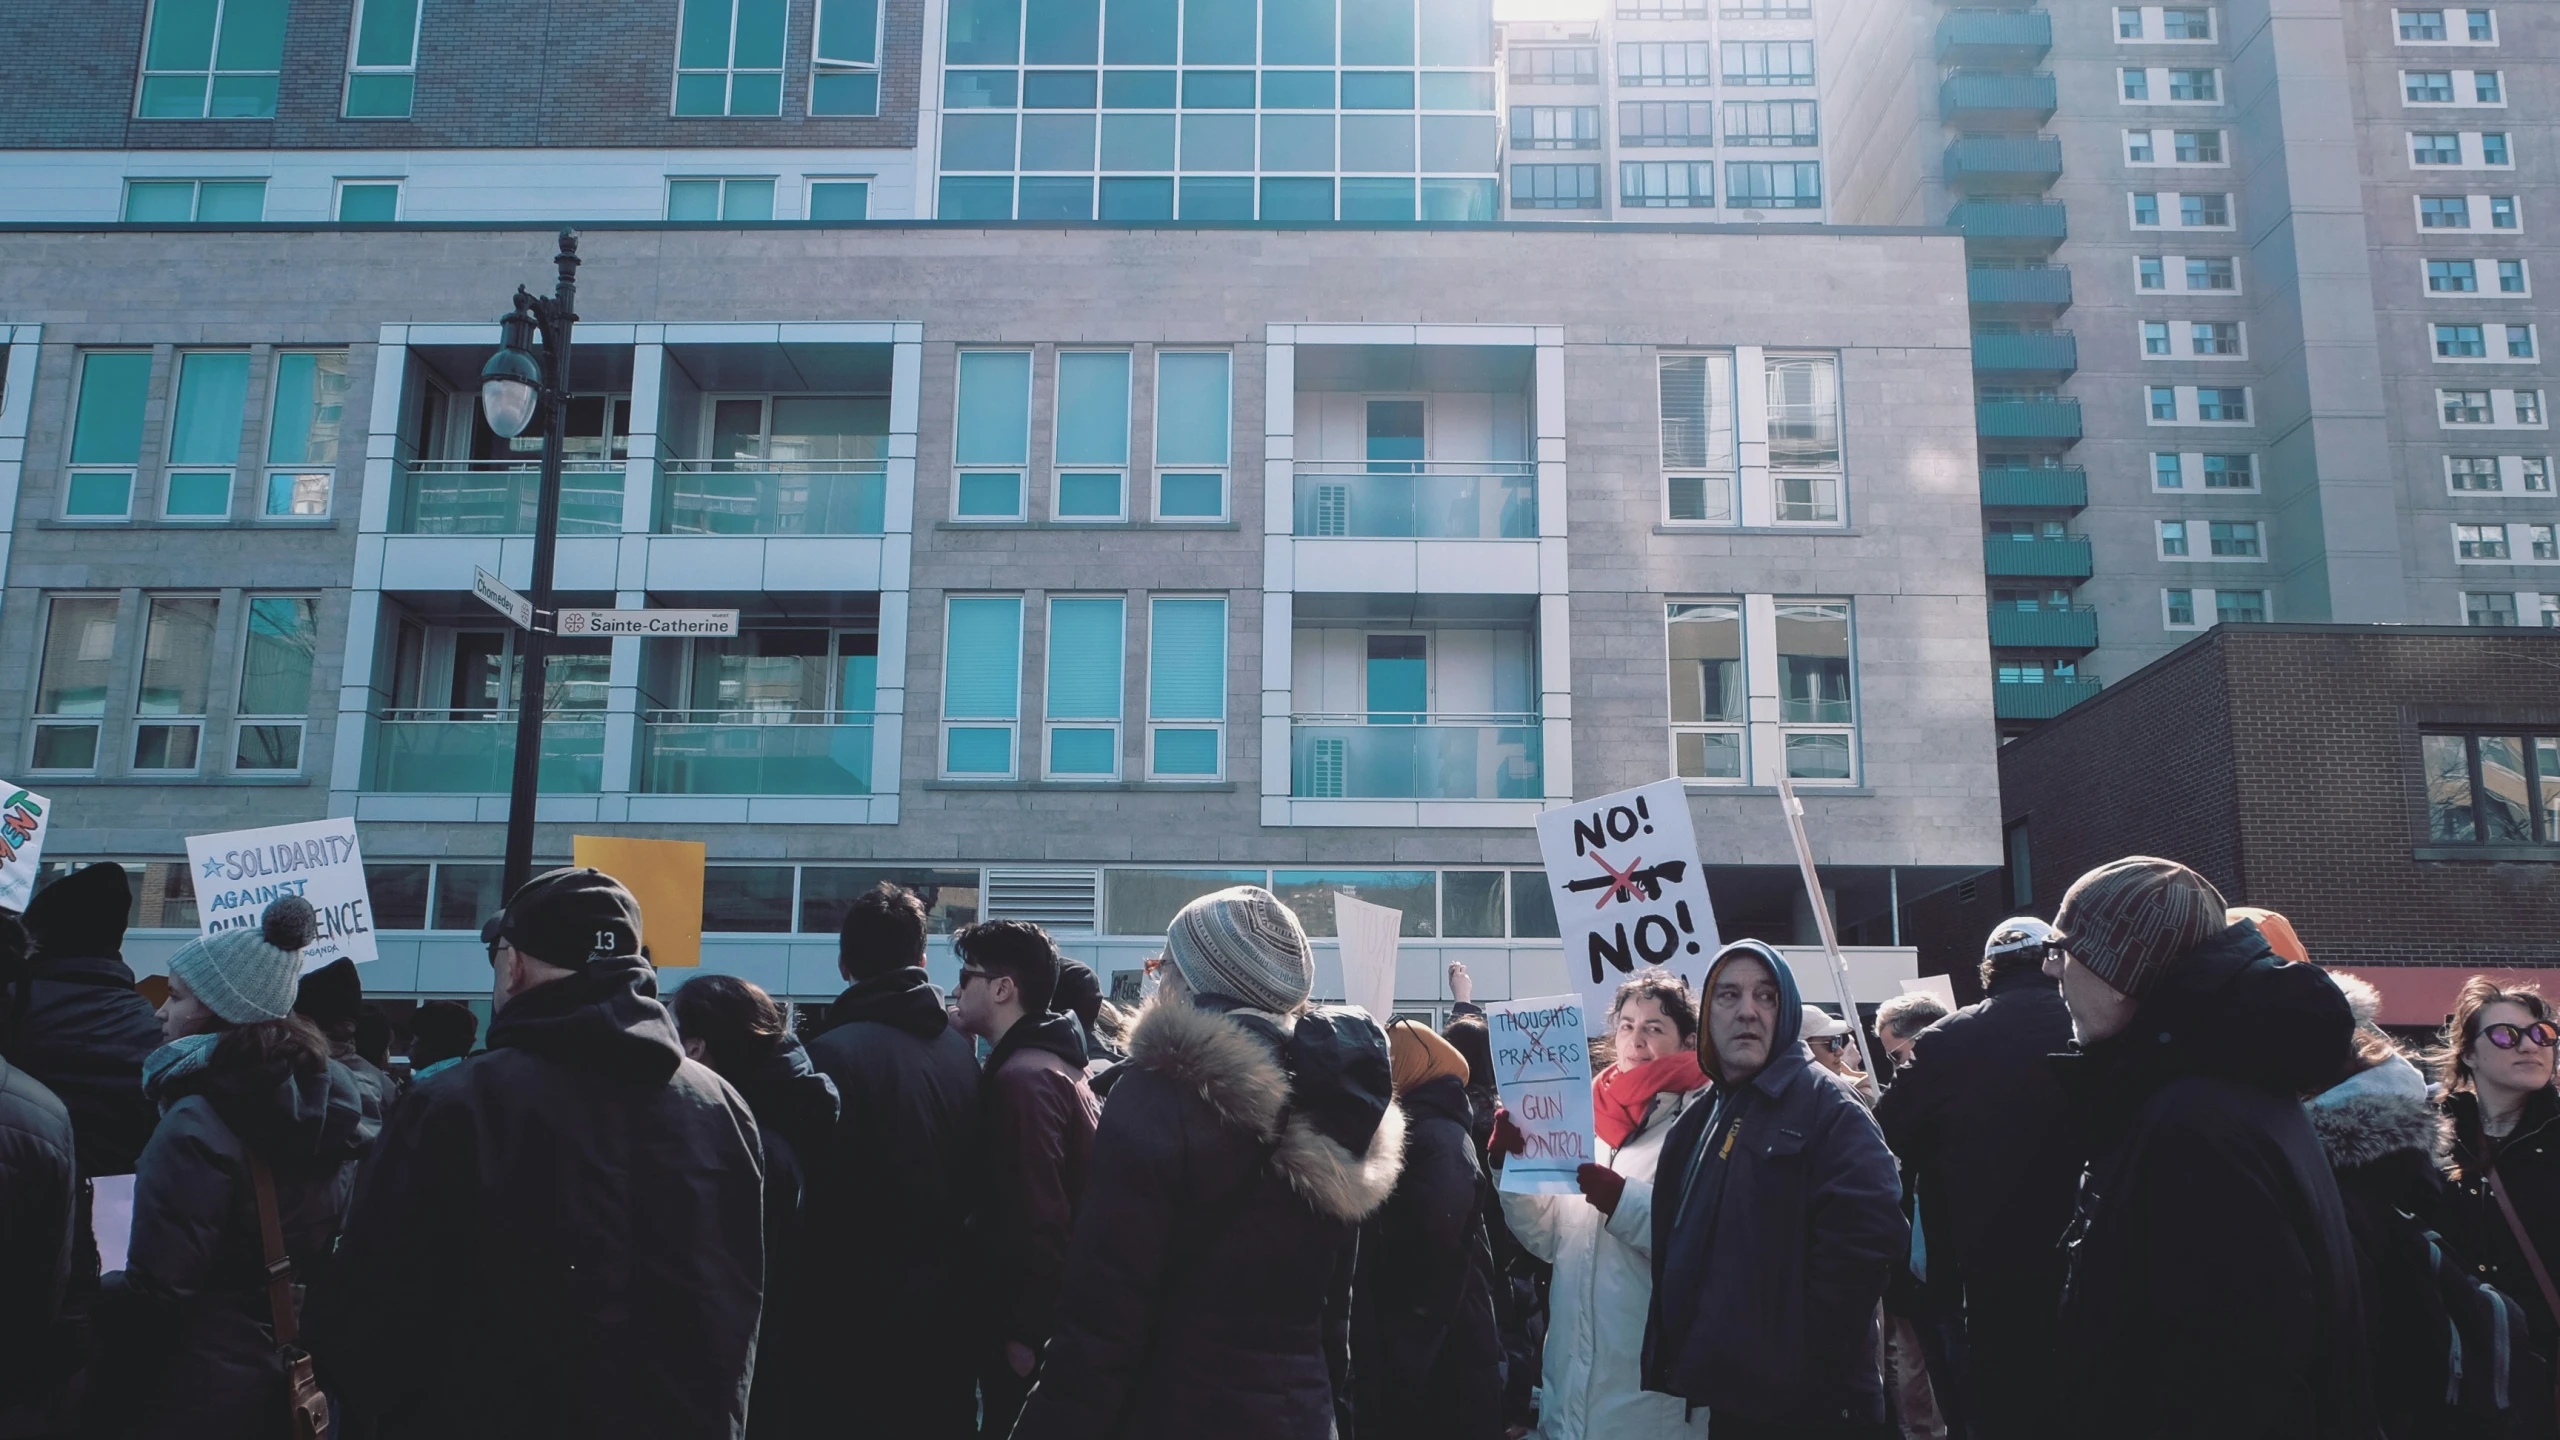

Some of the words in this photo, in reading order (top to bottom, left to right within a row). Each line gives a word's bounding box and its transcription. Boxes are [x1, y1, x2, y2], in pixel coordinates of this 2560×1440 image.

[477, 578, 514, 615] Chomedey
[590, 618, 729, 632] Sainte-Catherine
[1574, 795, 1654, 857] NO!
[225, 834, 355, 880] SOLIDARITY
[210, 879, 309, 912] AGAINST
[594, 930, 615, 950] 13
[1588, 900, 1701, 984] NO!
[1496, 1006, 1578, 1032] THOUGHTS
[1499, 1043, 1580, 1066] PRAYERS
[1522, 1092, 1563, 1121] GUN
